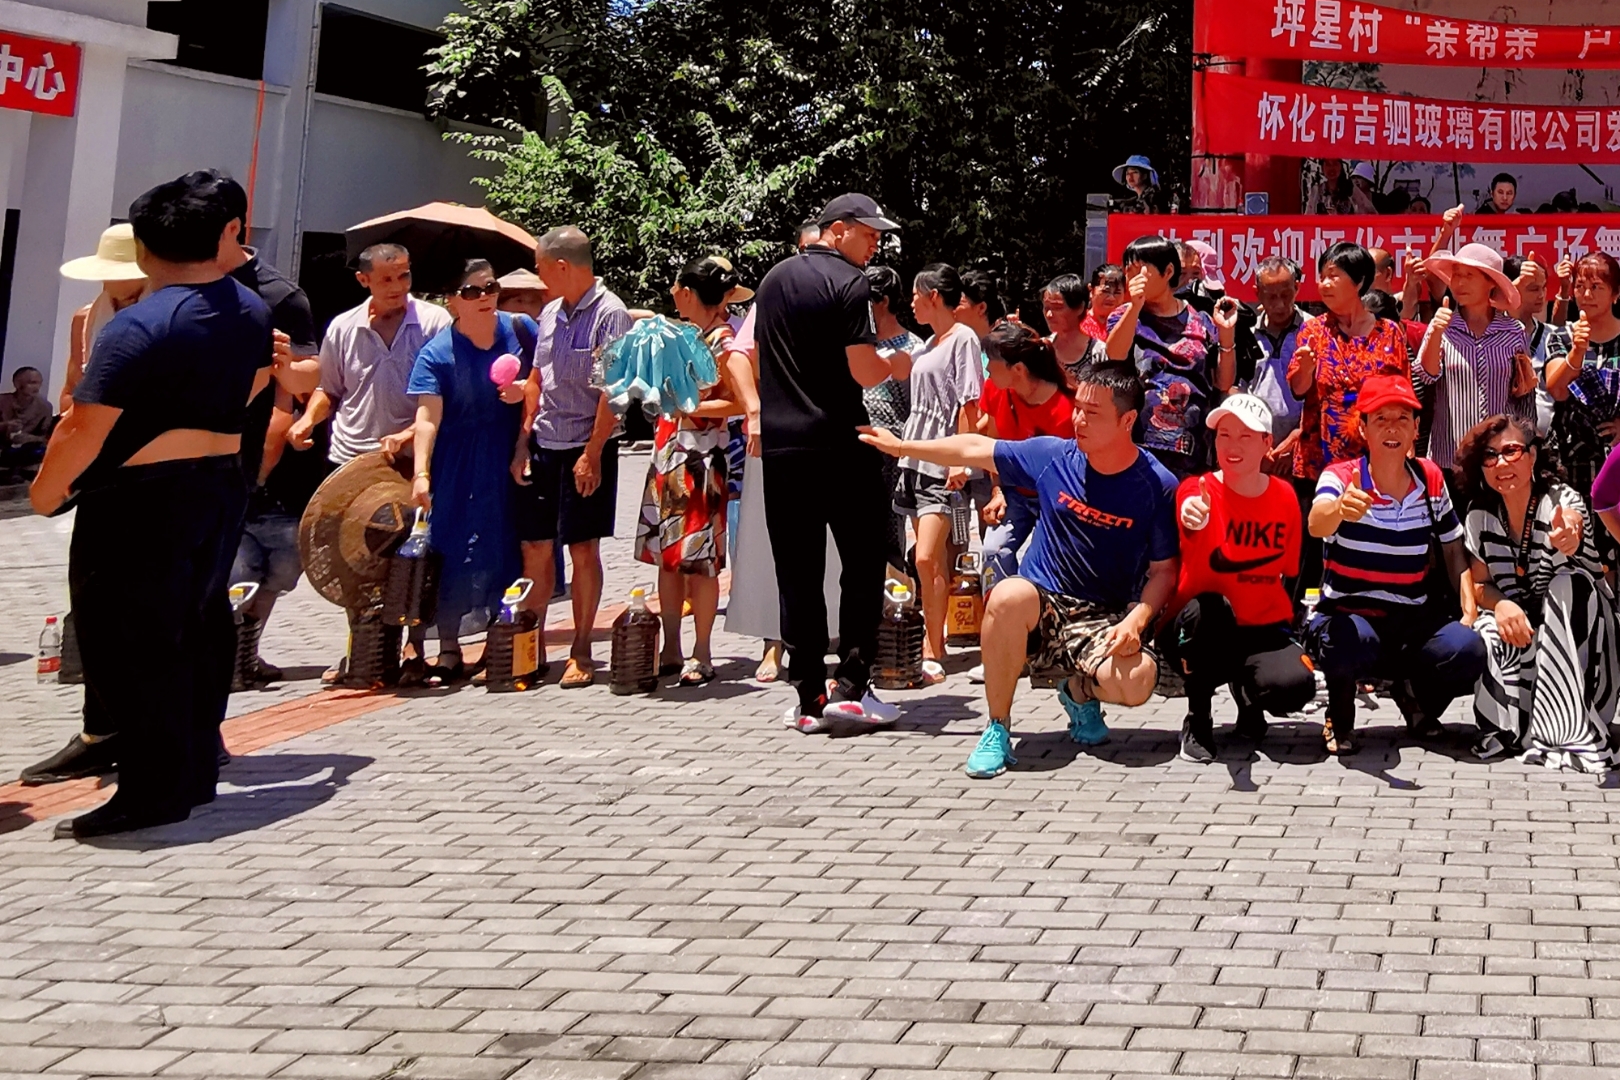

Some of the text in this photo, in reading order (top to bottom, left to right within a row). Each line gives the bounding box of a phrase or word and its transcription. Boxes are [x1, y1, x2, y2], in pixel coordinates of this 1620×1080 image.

[0, 44, 66, 101] 中心
[1227, 397, 1268, 419] ORT
[1225, 521, 1286, 550] NIKE
